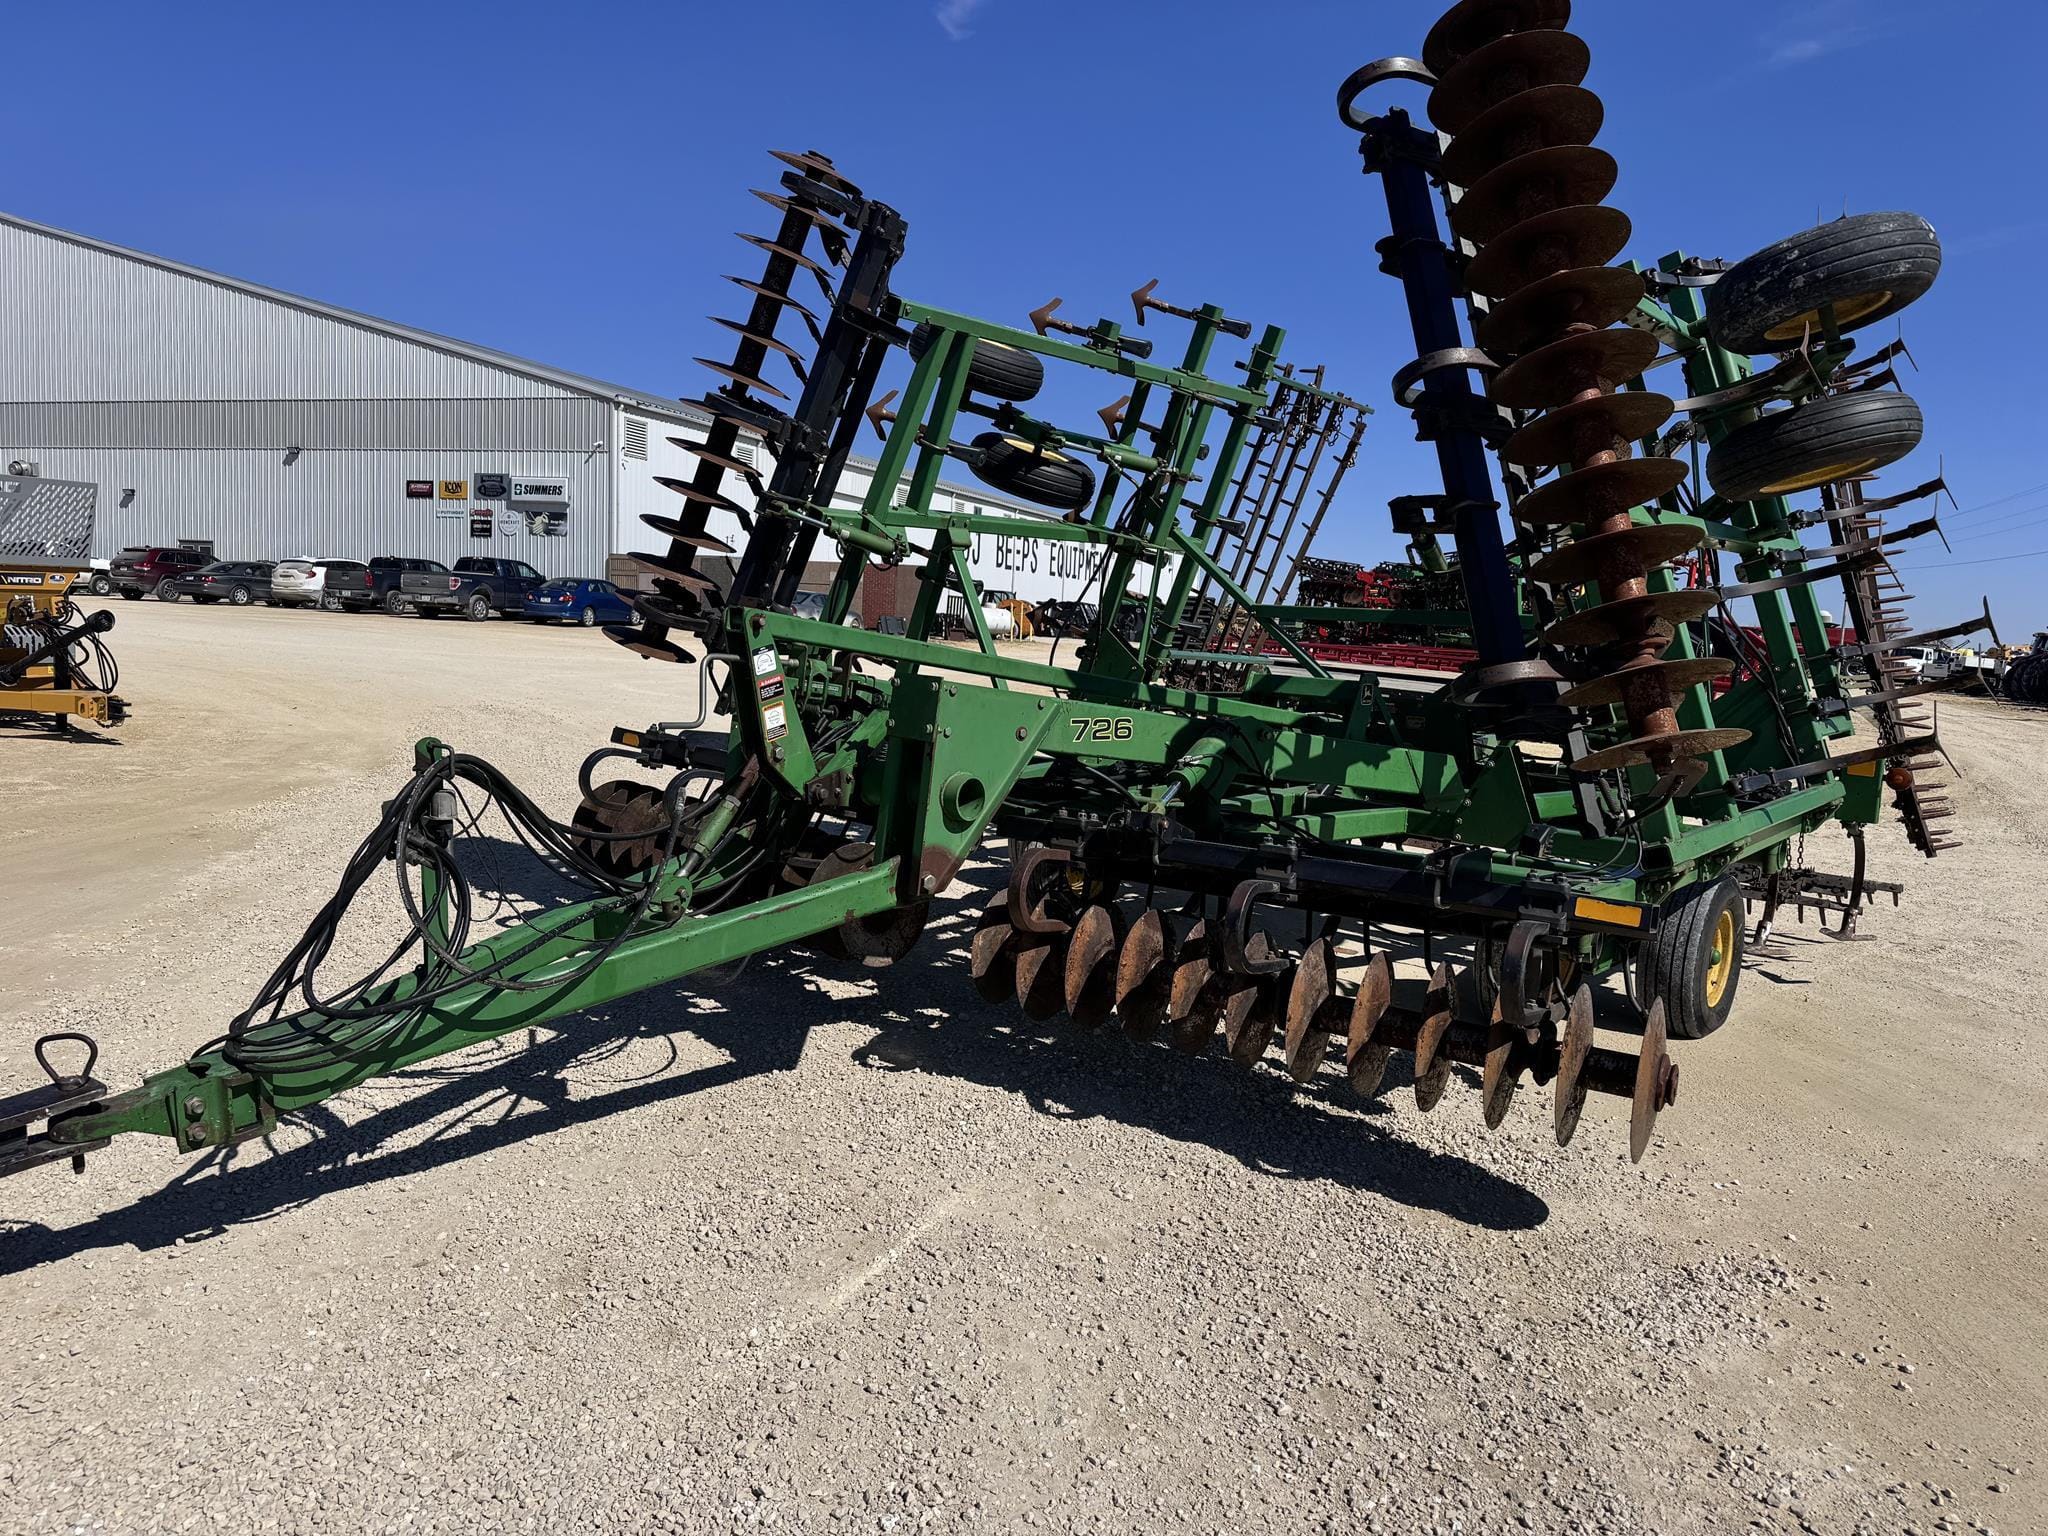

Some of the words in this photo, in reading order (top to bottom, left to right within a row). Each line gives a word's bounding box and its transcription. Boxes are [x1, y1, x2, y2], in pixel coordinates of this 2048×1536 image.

[444, 481, 463, 493] ICON
[523, 484, 563, 496] SUMMERS
[996, 535, 1038, 573] BEEPS
[7, 576, 42, 584] NITRO
[1070, 717, 1133, 742] 726
